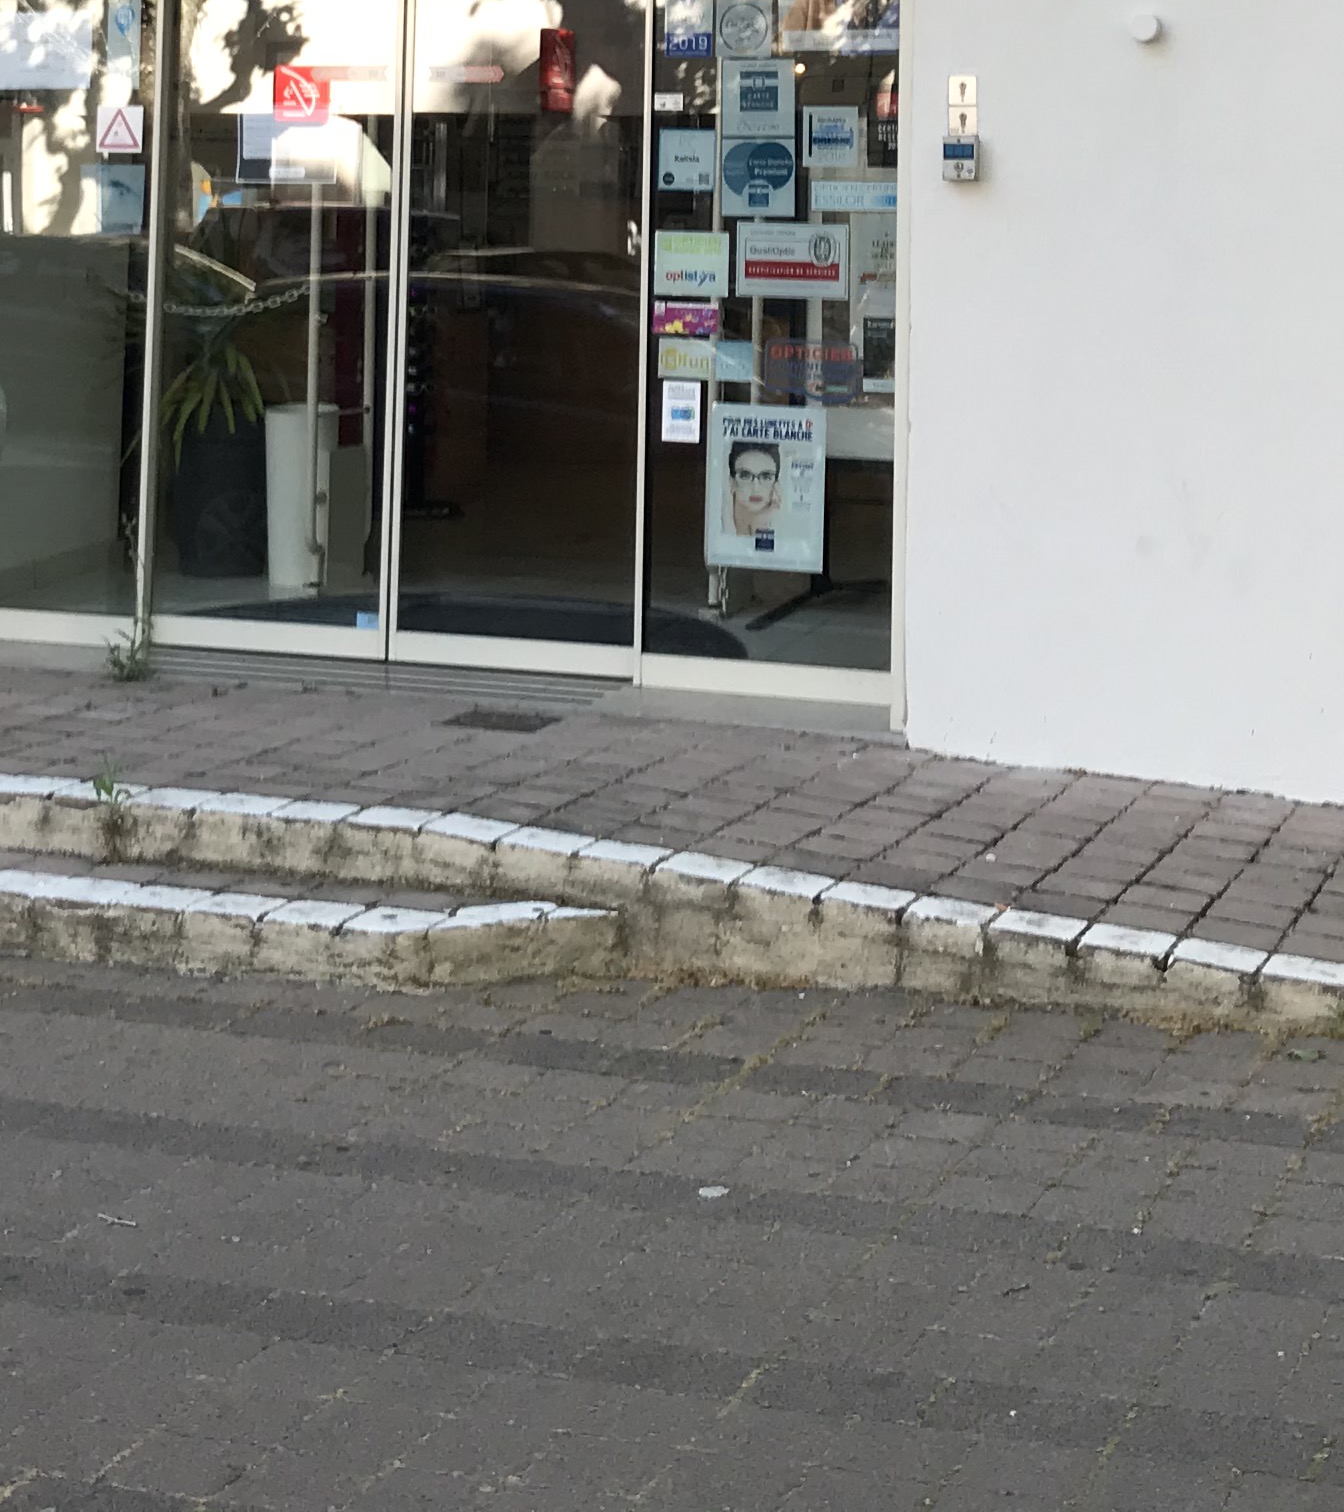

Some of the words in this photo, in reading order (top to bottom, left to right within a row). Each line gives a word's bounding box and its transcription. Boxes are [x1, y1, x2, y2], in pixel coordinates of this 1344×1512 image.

[669, 36, 708, 51] 2019
[770, 345, 854, 362] OPTICIEN
[742, 428, 770, 439] CARTE
[772, 429, 814, 442] BLANCHE
